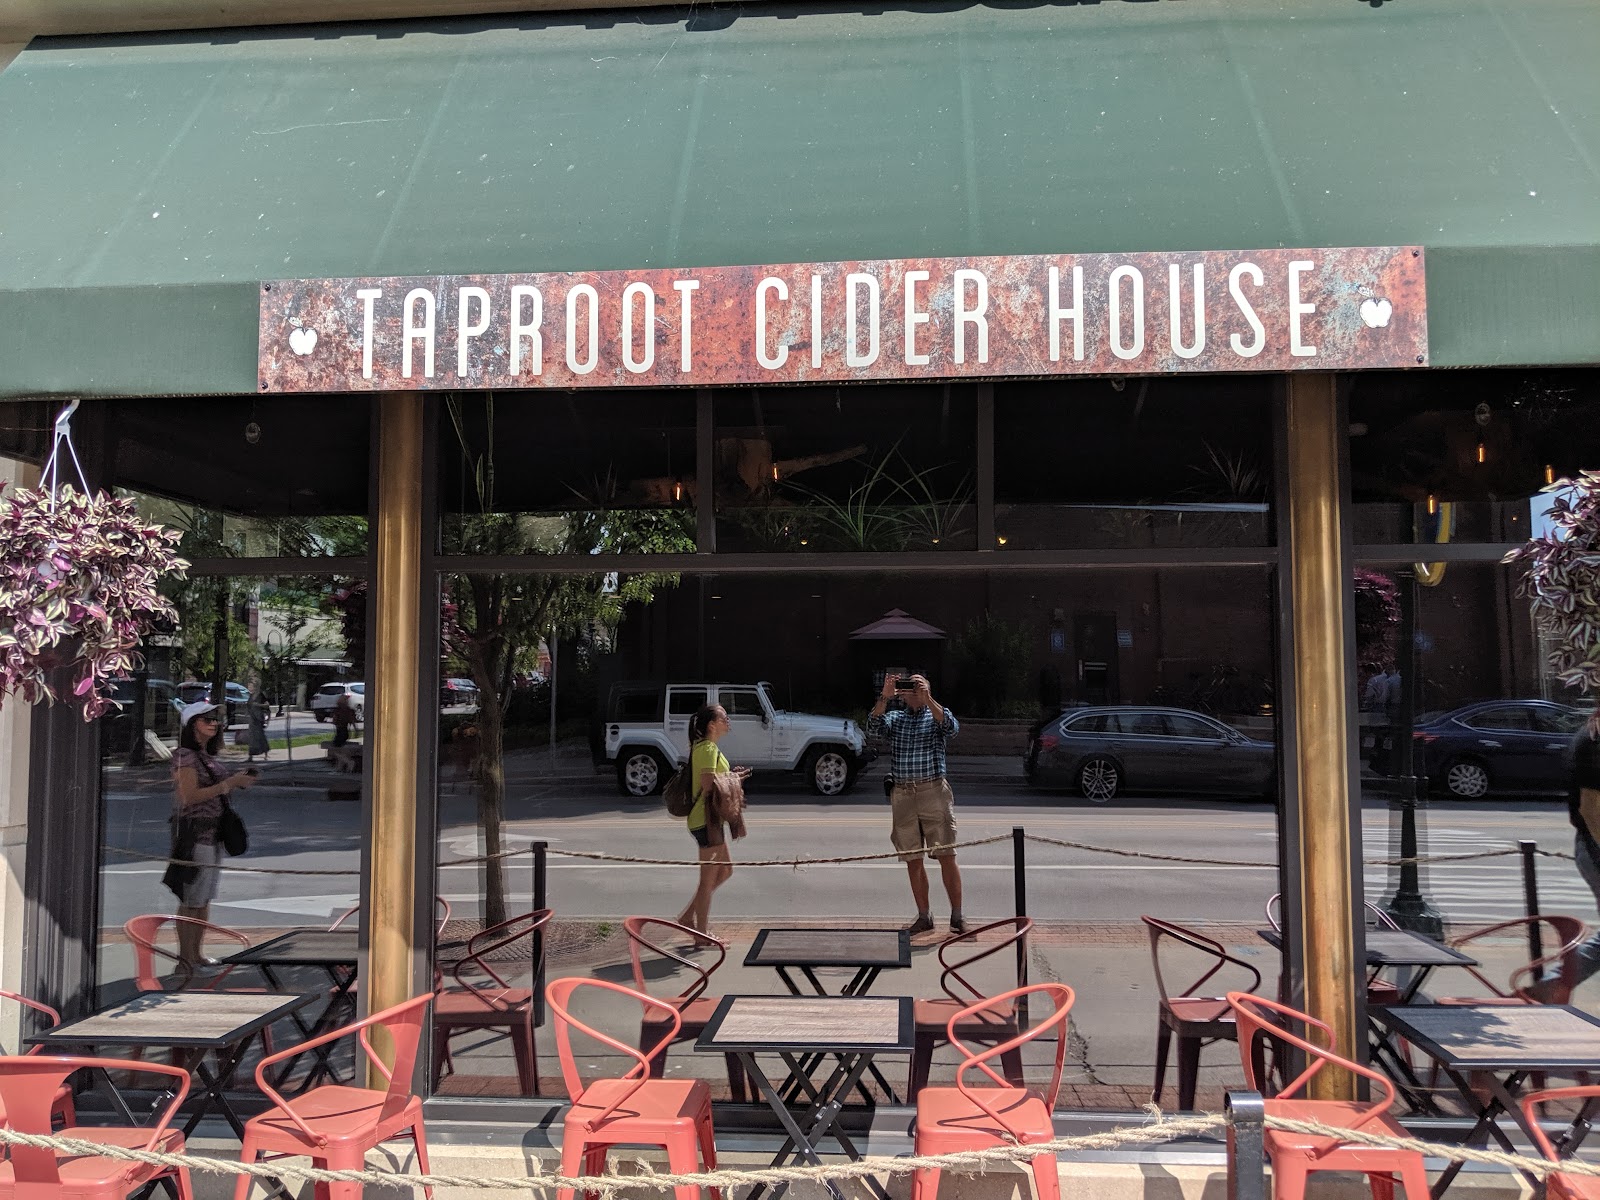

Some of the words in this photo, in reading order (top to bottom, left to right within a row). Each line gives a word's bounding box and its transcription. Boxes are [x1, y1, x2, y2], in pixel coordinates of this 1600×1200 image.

[356, 279, 700, 379] TAPROOT
[755, 269, 989, 370] CIDER
[1048, 260, 1318, 363] HOUSE
